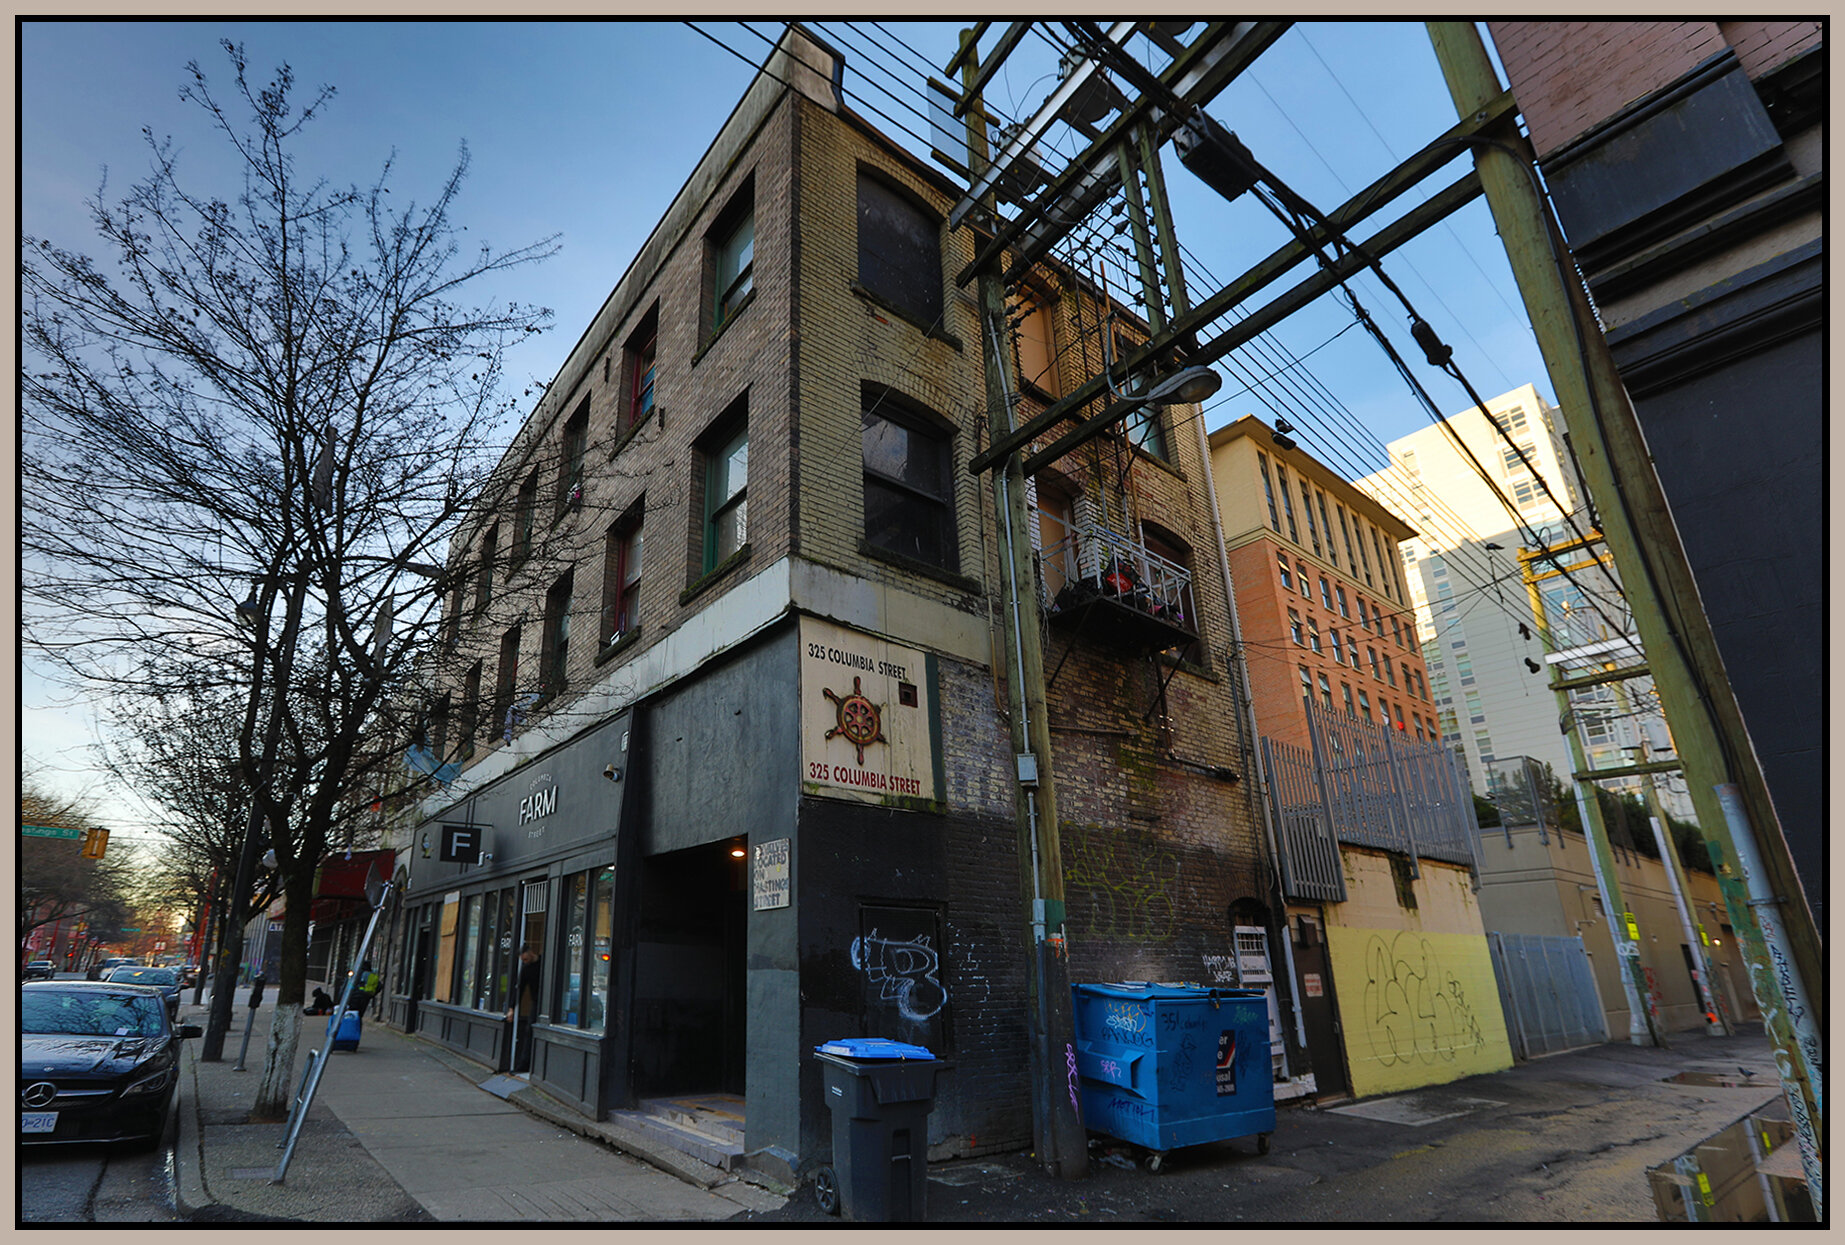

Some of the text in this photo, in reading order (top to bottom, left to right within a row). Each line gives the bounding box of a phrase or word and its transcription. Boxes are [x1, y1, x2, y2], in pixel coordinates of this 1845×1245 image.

[808, 643, 907, 681] 325 COLUMBIA STREET
[809, 762, 921, 796] 325 COLUMBIA STREET
[518, 785, 557, 826] FARM
[451, 832, 472, 857] F
